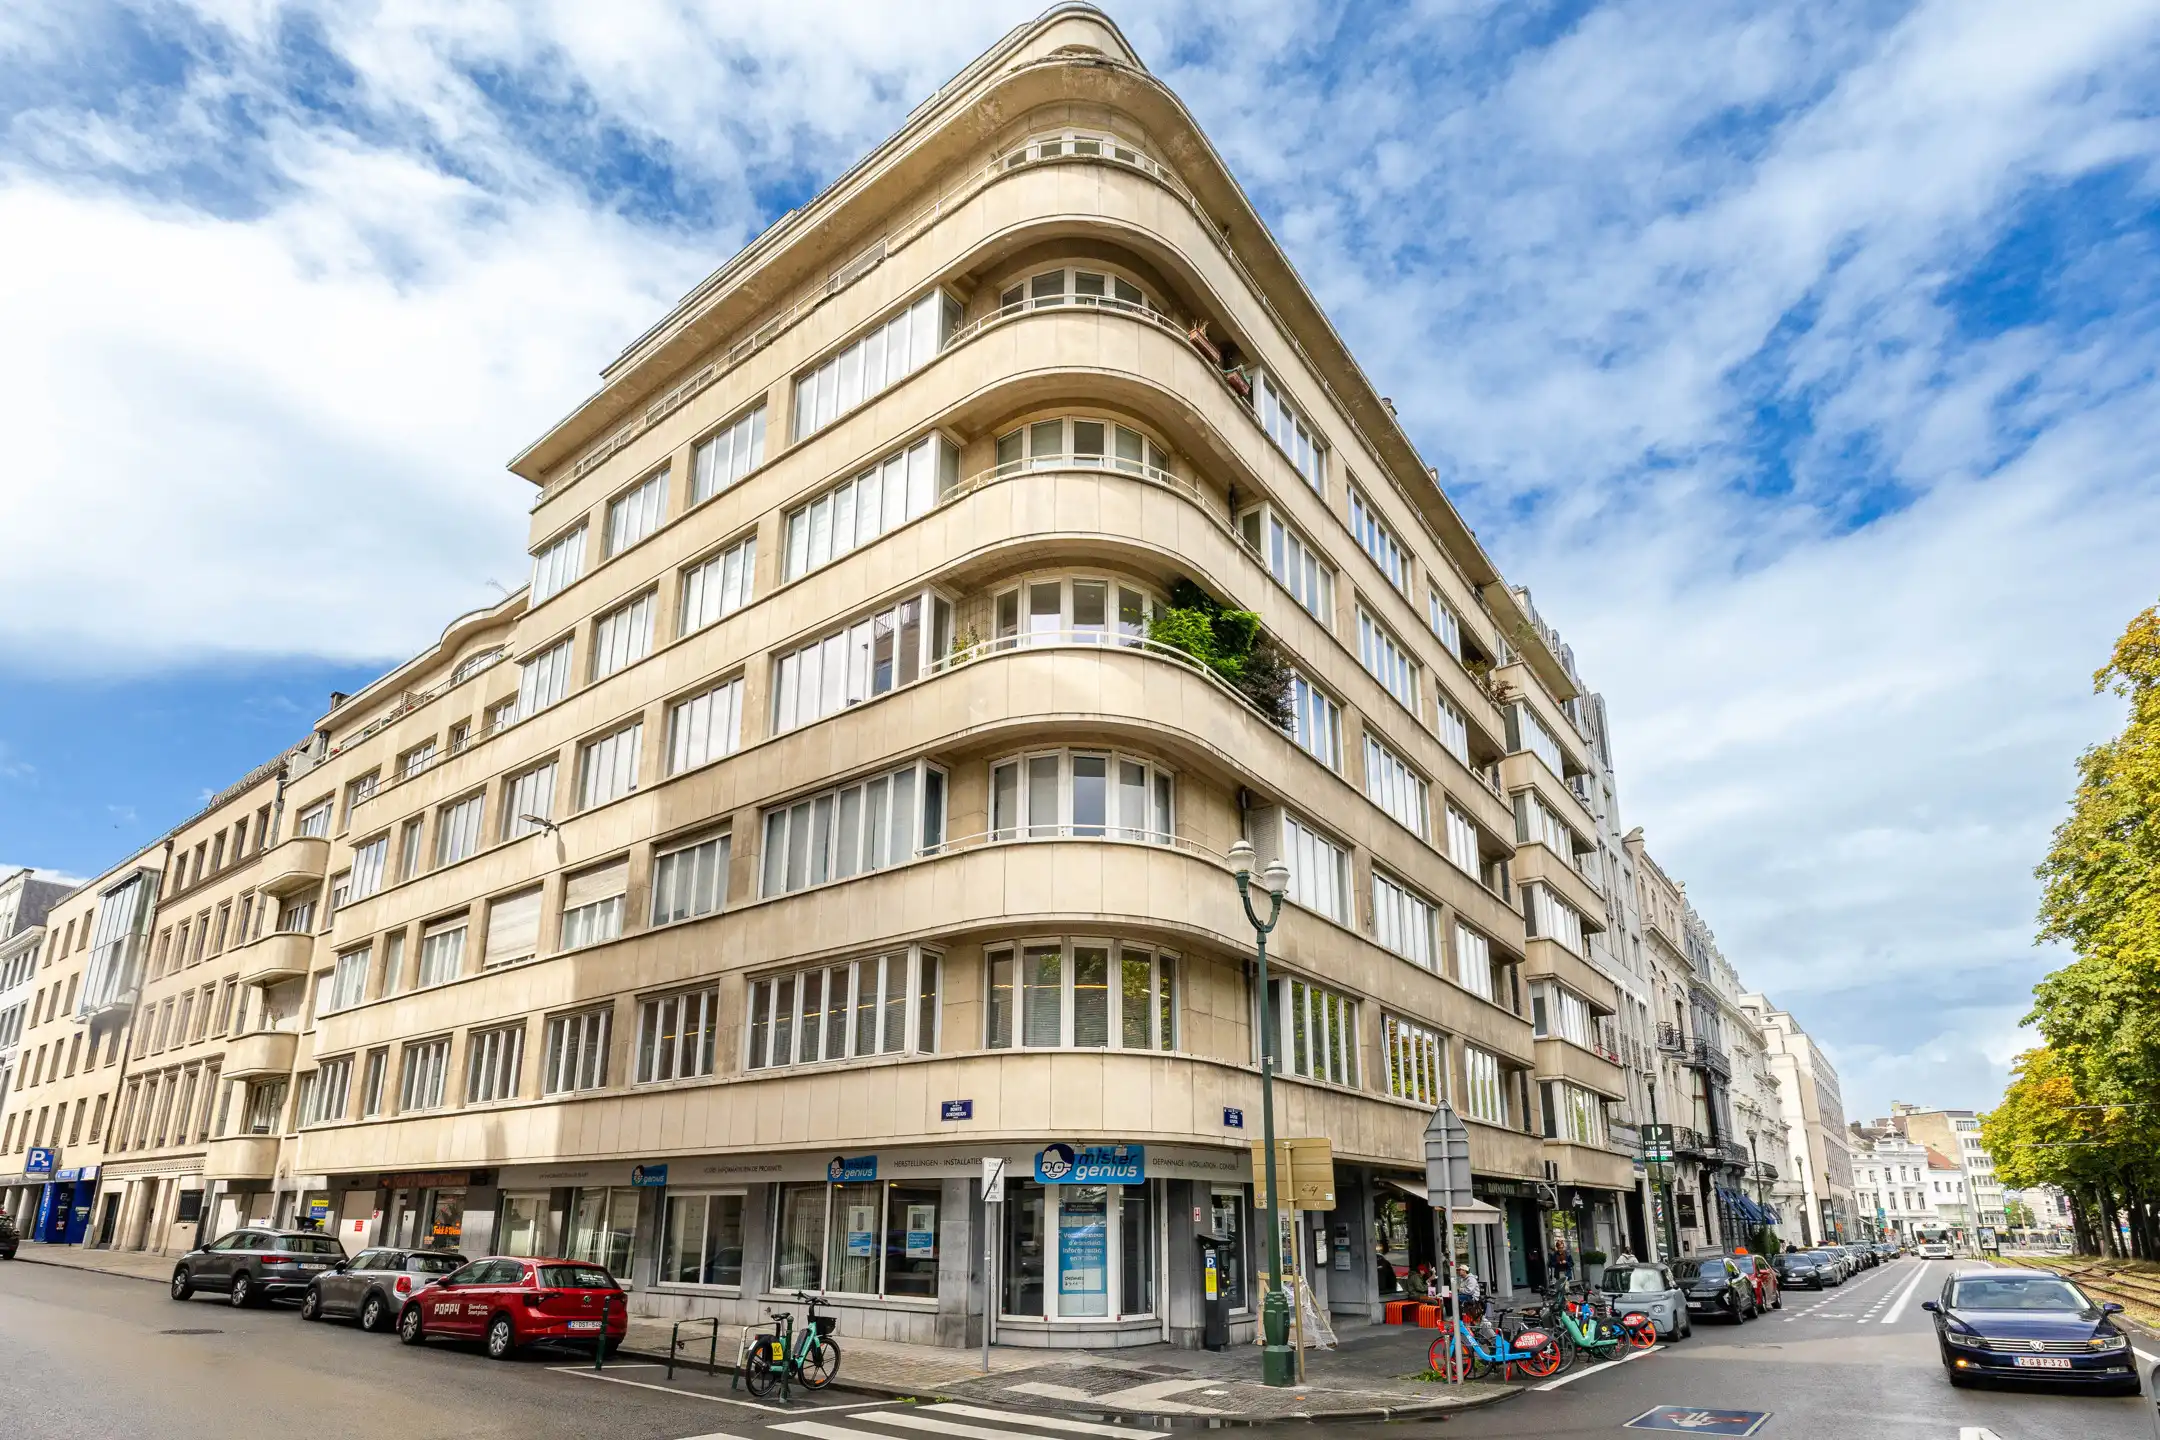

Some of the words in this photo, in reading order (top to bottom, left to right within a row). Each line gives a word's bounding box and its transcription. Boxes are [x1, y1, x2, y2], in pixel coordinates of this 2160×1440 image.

[29, 1150, 46, 1167] P
[1078, 1146, 1138, 1165] mister
[893, 1158, 939, 1168] HERSTELLINGEN
[943, 1156, 983, 1166] INSTALLATIES
[844, 1168, 873, 1180] genius
[1075, 1165, 1138, 1180] genius
[1206, 1257, 1214, 1268] P
[433, 1303, 460, 1315] POPPY
